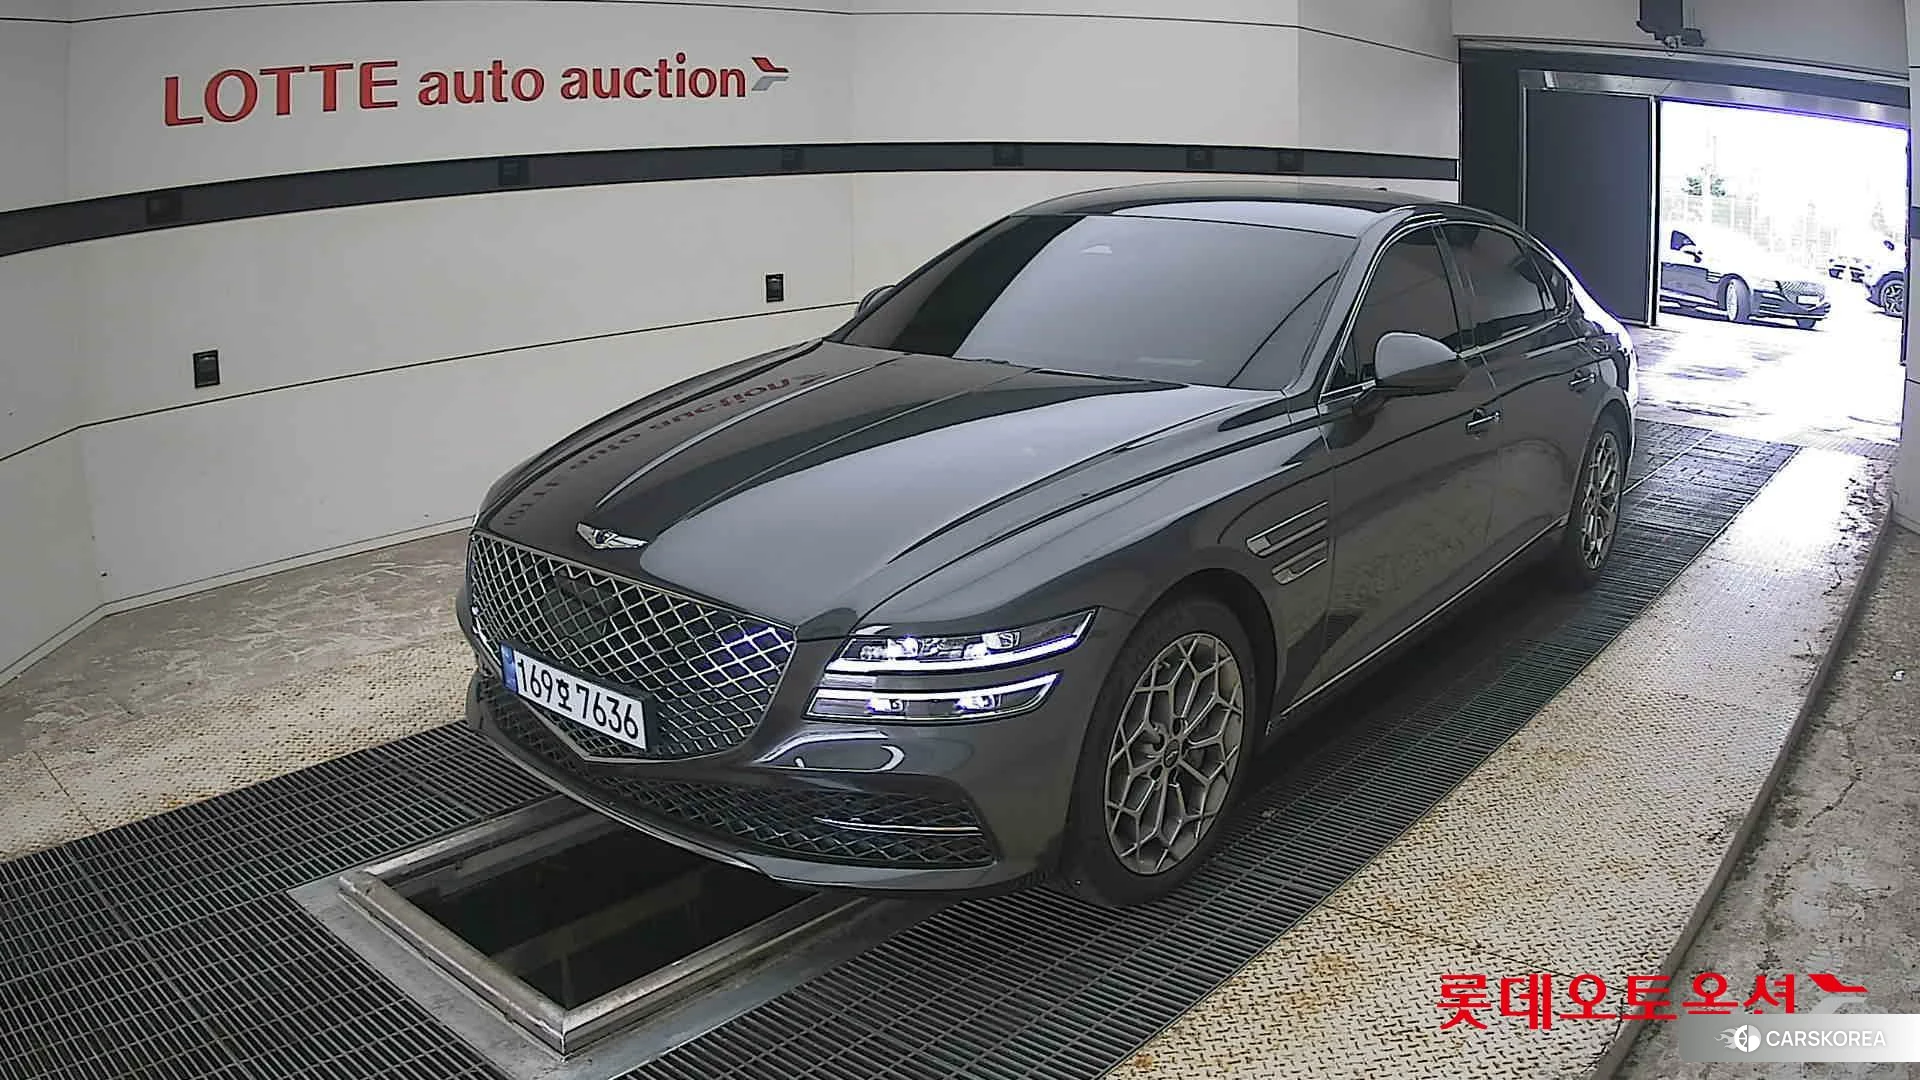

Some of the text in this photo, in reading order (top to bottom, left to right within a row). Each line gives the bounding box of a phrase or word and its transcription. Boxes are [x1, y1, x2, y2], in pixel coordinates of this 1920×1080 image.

[164, 52, 747, 127] LOTTE auto auction
[575, 683, 639, 740] 7636
